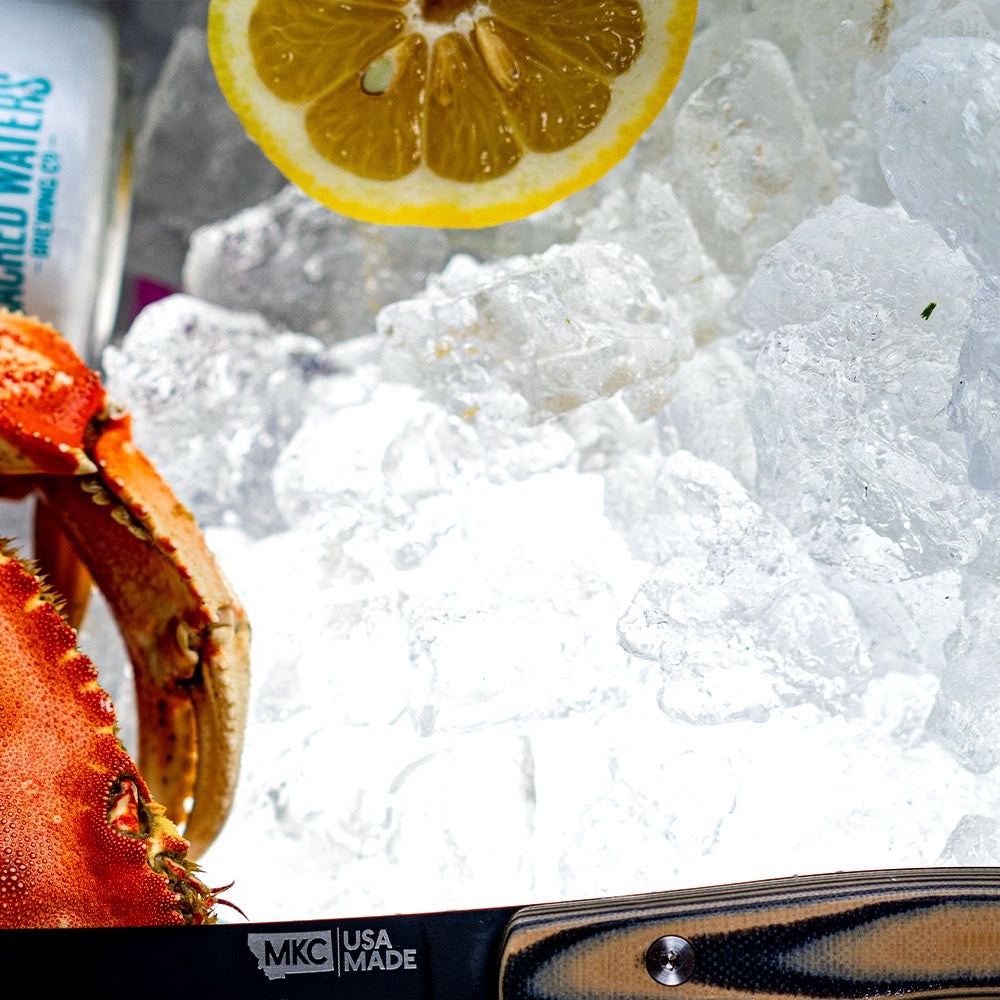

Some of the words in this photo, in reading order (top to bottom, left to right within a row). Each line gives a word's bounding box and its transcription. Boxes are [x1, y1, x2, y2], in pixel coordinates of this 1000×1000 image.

[343, 928, 393, 951] USA
[264, 938, 328, 967] MKC
[343, 948, 418, 973] MADE
